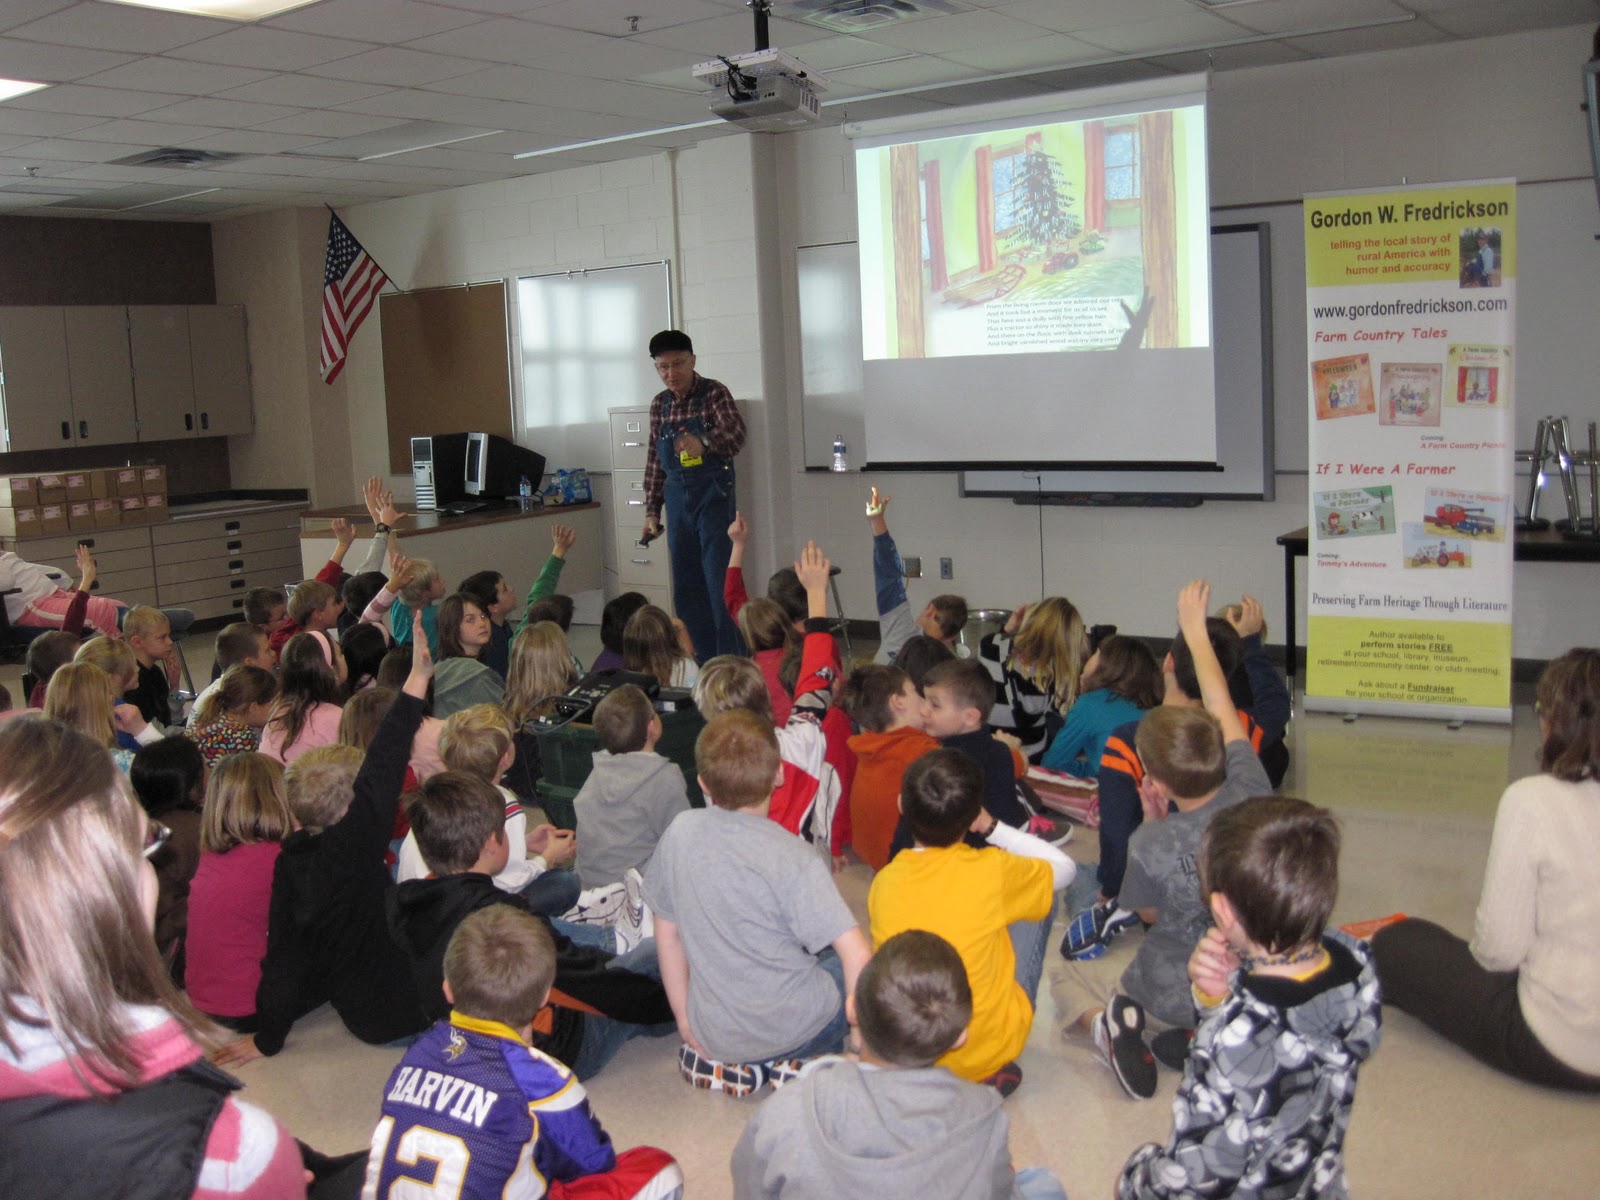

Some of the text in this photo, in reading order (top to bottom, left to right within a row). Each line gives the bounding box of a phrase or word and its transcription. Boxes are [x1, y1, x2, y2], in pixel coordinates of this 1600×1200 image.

[1311, 200, 1509, 228] Gordon W. Fredrickson
[1331, 233, 1451, 250] telling the local story of
[1357, 248, 1451, 262] rural America with
[1346, 262, 1451, 276] humor and accuracy
[1313, 298, 1507, 320] www.gordonfredrickson.com
[1314, 327, 1448, 342] Farm Country Tales
[1450, 442, 1480, 450] Country
[1316, 464, 1456, 475] If I Were A Farmer
[1312, 593, 1508, 612] Preserving Farm Heritage Through Literature
[1369, 630, 1396, 639] Author
[1398, 632, 1434, 640] available
[1360, 640, 1453, 652] perform stories FREE
[1317, 659, 1402, 670] retirement/community
[1445, 664, 1462, 672] club
[1358, 680, 1373, 688] Ask
[1375, 681, 1398, 690] about
[1408, 683, 1454, 692] Fundraiser
[1378, 691, 1404, 699] school
[387, 1066, 498, 1128] HARVIN
[360, 1115, 470, 1200] 12
